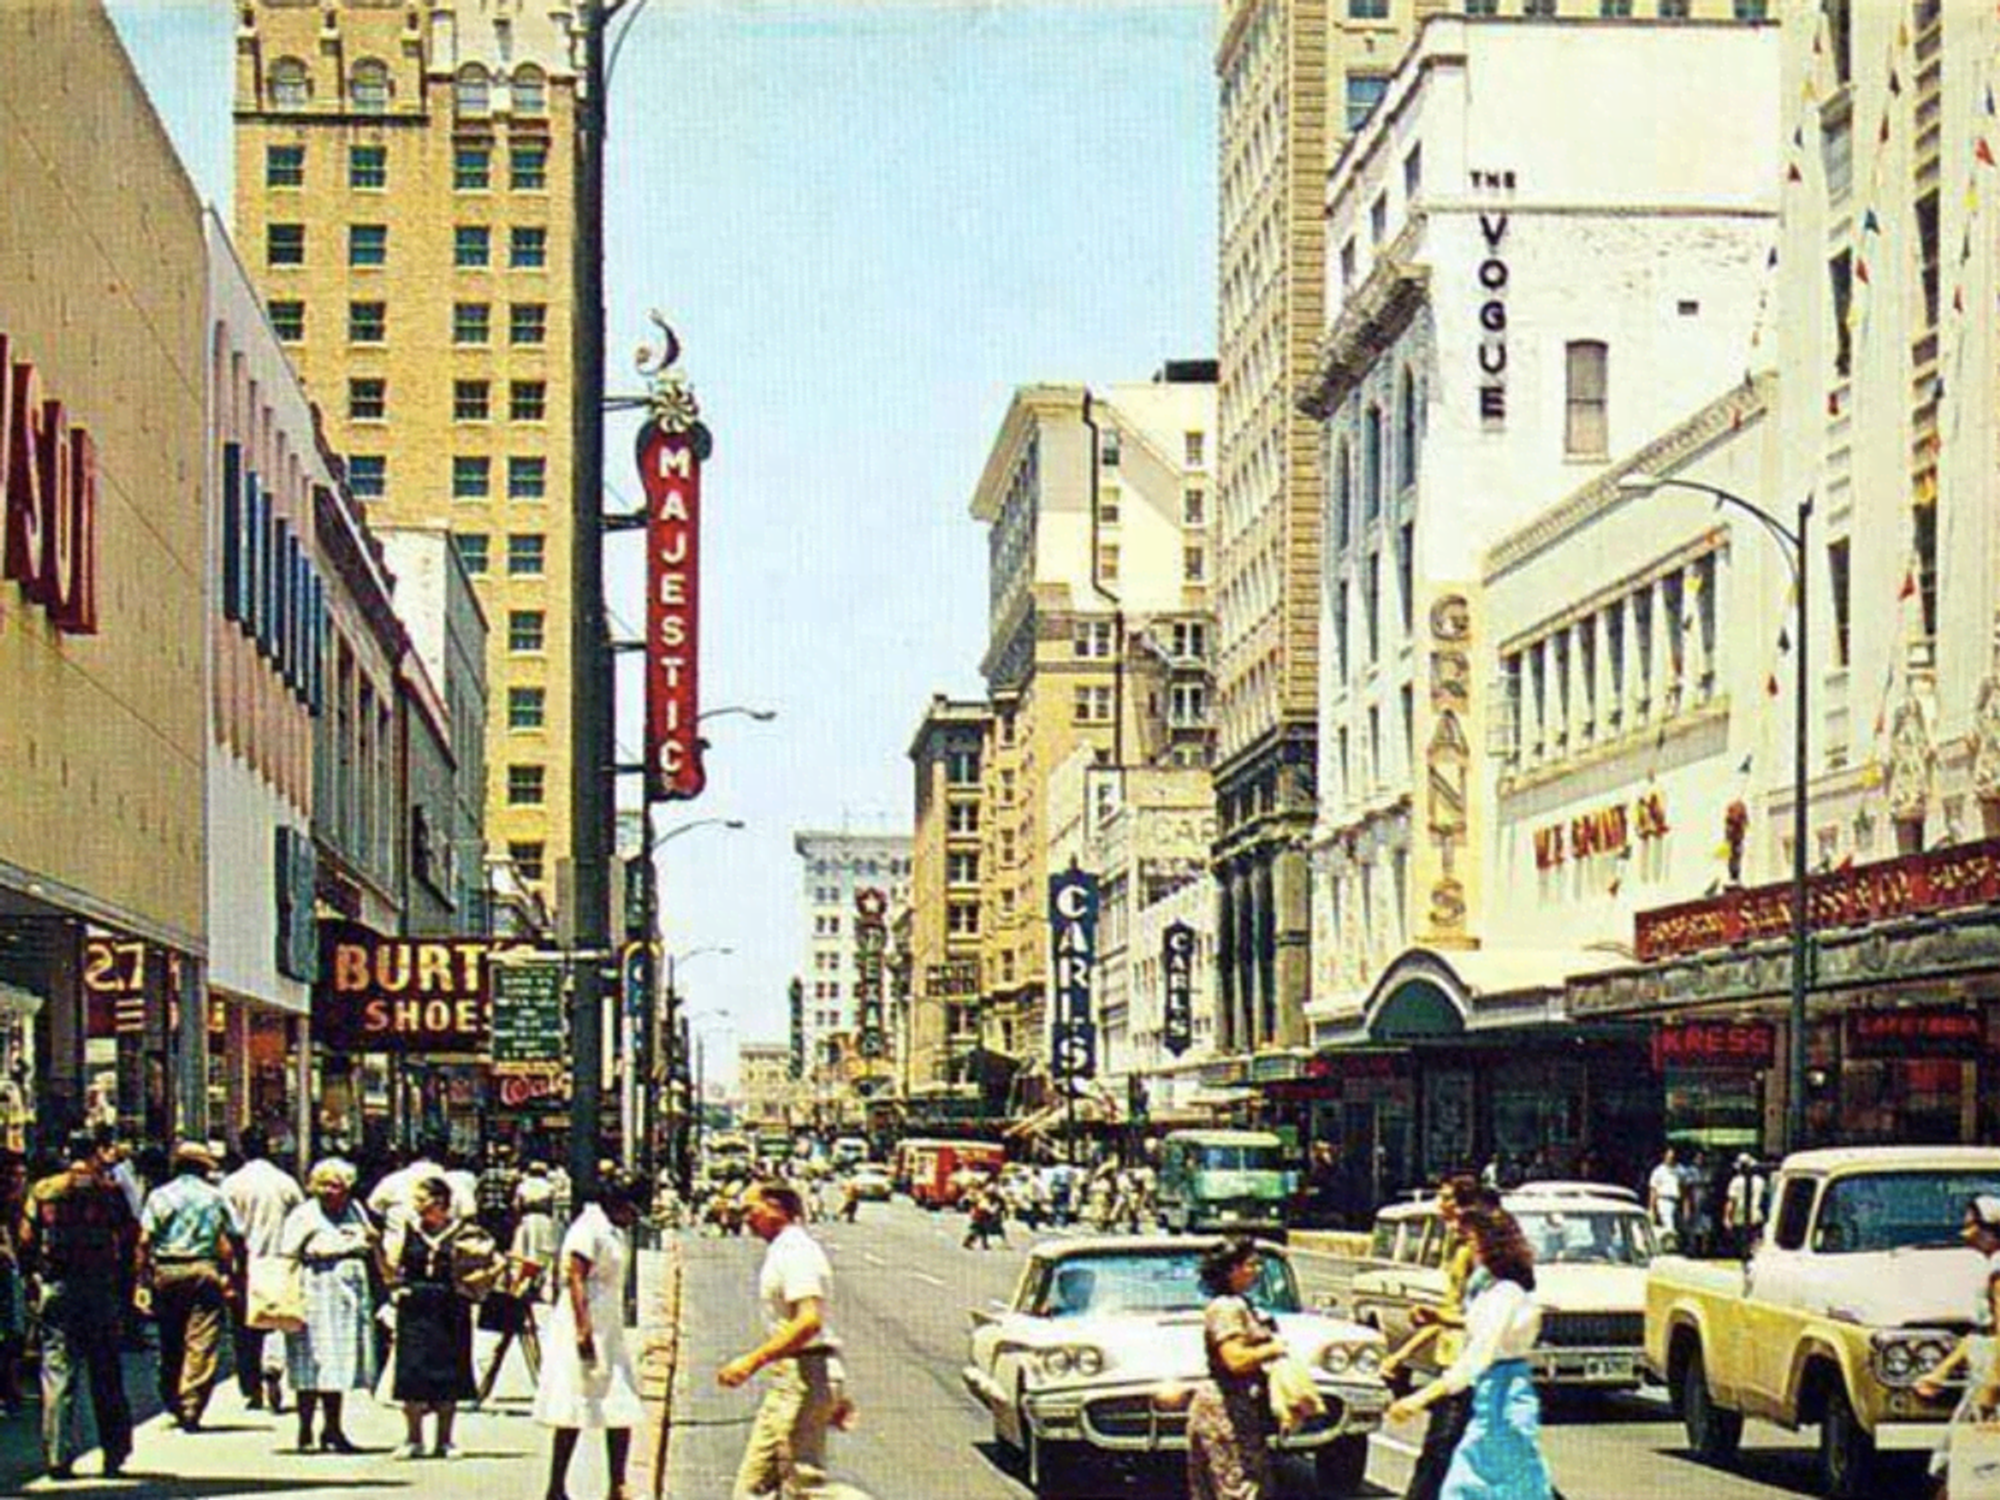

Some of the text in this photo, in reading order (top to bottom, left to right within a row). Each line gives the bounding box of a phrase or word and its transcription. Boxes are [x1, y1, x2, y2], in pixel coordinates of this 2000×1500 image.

[1470, 171, 1516, 189] THE
[1478, 215, 1509, 420] VOGUE
[659, 446, 689, 773] MAJESTIC
